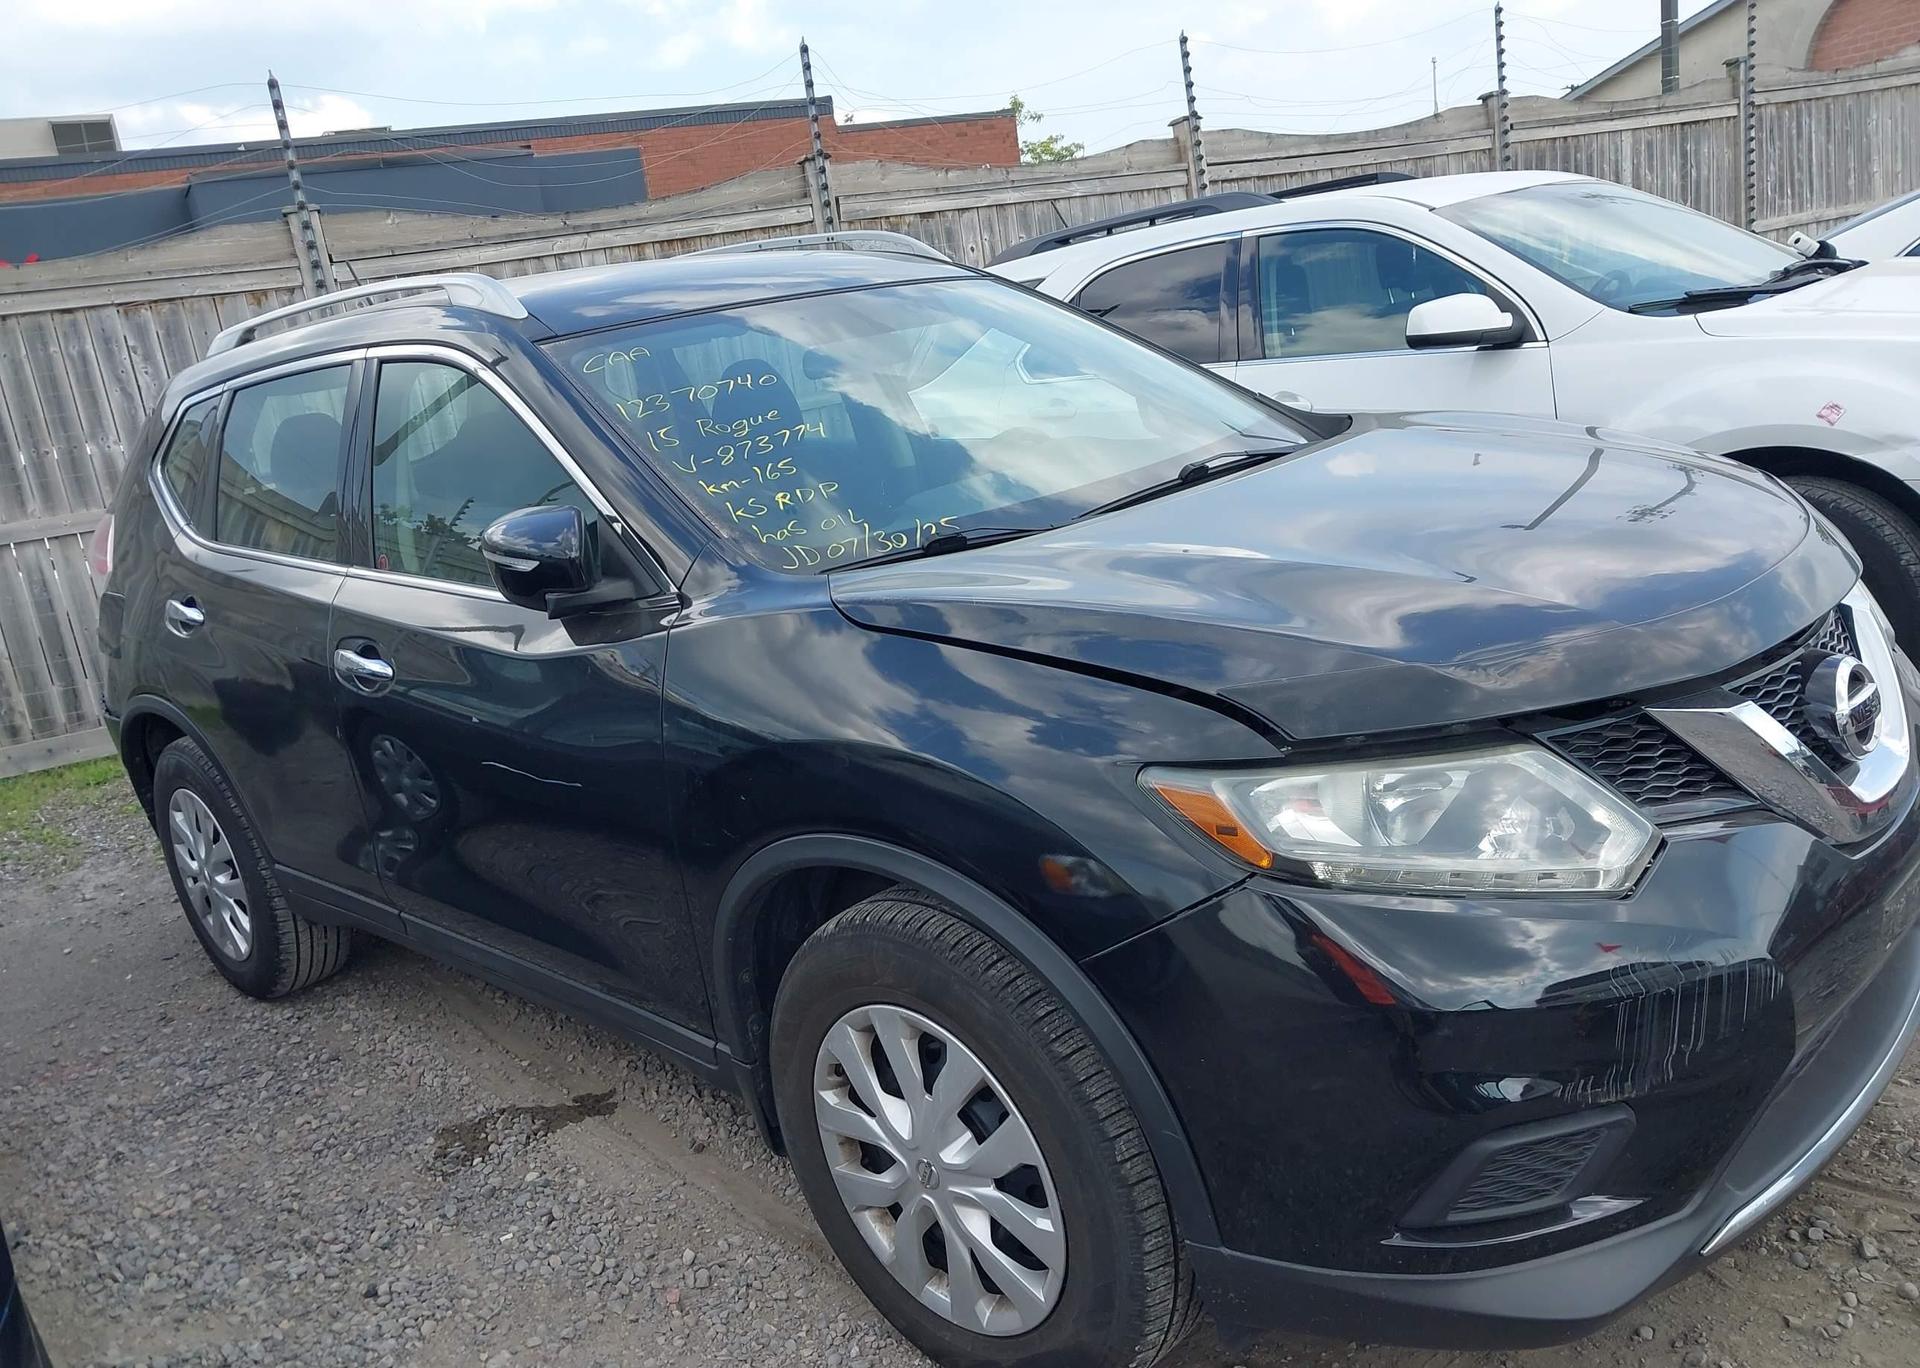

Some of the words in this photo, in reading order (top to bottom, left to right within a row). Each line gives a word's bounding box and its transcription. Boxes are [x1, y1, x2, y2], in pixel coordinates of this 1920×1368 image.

[583, 347, 650, 373] CAA
[647, 425, 679, 452] 15
[696, 409, 782, 438] Rogue
